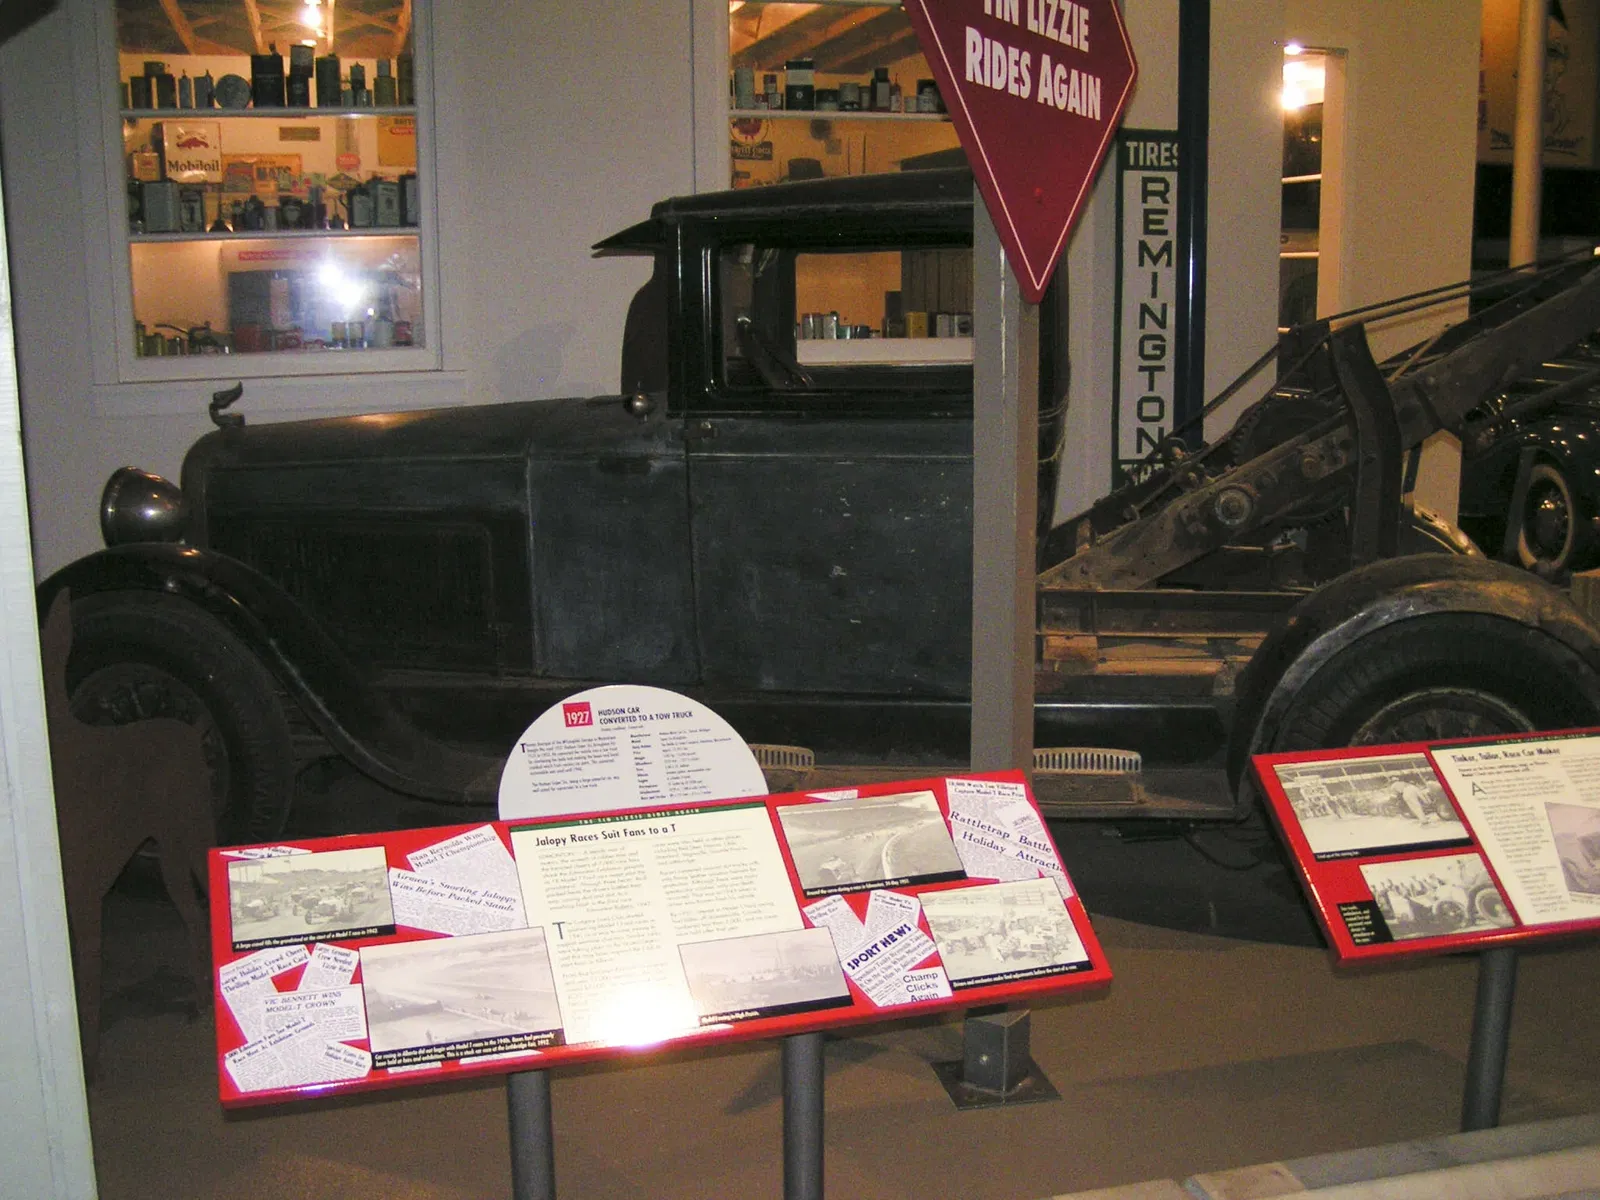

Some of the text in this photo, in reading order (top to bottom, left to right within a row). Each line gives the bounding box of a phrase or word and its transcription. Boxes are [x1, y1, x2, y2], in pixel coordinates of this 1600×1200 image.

[1027, 0, 1090, 52] LIZZIE
[965, 26, 1101, 121] RIDES AGAIN
[168, 159, 220, 173] Mobiloil
[1136, 176, 1173, 454] REMINGTON
[566, 711, 590, 725] 1927
[598, 706, 640, 717] HUDSON CAR
[600, 716, 636, 726] CONVERTED
[656, 713, 671, 721] TOW
[672, 711, 693, 719] TRUCK
[464, 832, 484, 841] Wins
[536, 834, 567, 847] Jalopy
[571, 832, 598, 843] Races
[602, 829, 620, 840] Suit
[624, 827, 645, 837] Fans
[649, 826, 659, 835] to
[670, 823, 677, 832] T
[950, 811, 1010, 839] Rattletrap
[1019, 835, 1052, 854] Battle
[415, 857, 437, 868] Model
[446, 835, 497, 857] Championship
[962, 831, 1062, 872] Holiday Attracti
[392, 881, 515, 912] Wins Before Packed Stands
[847, 924, 912, 970] SPORT NEWS
[902, 971, 938, 983] Champ
[906, 982, 938, 993] Clicks
